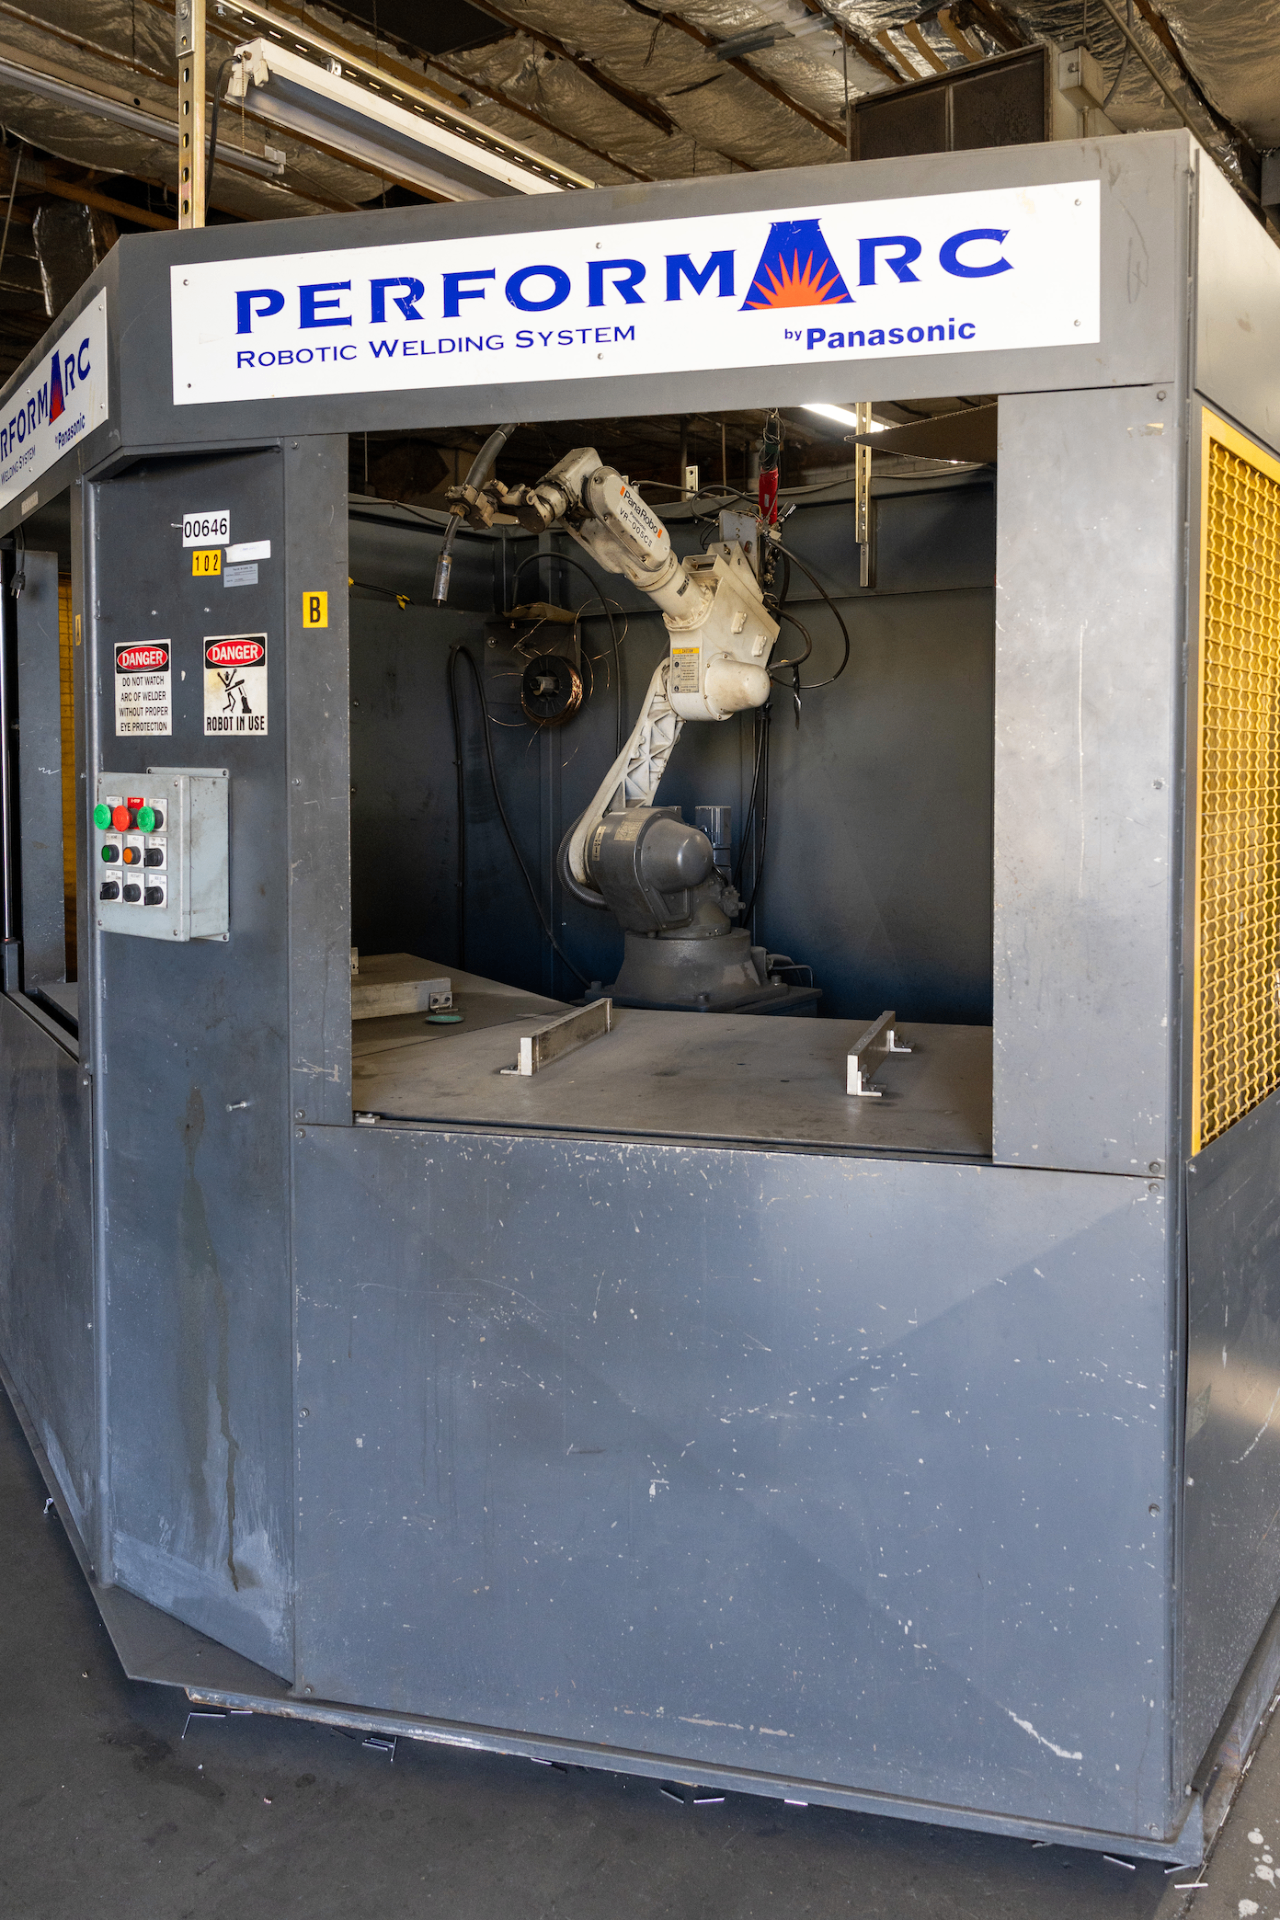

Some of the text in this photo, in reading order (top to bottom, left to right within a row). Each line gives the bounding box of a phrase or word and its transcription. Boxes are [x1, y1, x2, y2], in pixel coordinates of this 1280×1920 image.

[234, 218, 1014, 335] PERFORMARC
[784, 317, 976, 350] by Panasonic
[236, 325, 636, 369] ROBOTIC WELDING SYSTEM
[58, 412, 85, 450] Panasonic
[623, 490, 659, 534] PanaRobo
[184, 517, 228, 538] 00646
[195, 553, 219, 572] 102
[309, 596, 321, 624] B
[122, 650, 164, 667] DANGER
[212, 644, 259, 661] DANGER
[122, 675, 165, 687] DO NOT WATCH
[121, 691, 167, 702] ARC OF WELDER
[119, 706, 168, 717] WITHOUT PROPER
[120, 721, 168, 732] EYE PROTECTION
[206, 715, 265, 731] ROBOT IN USE
